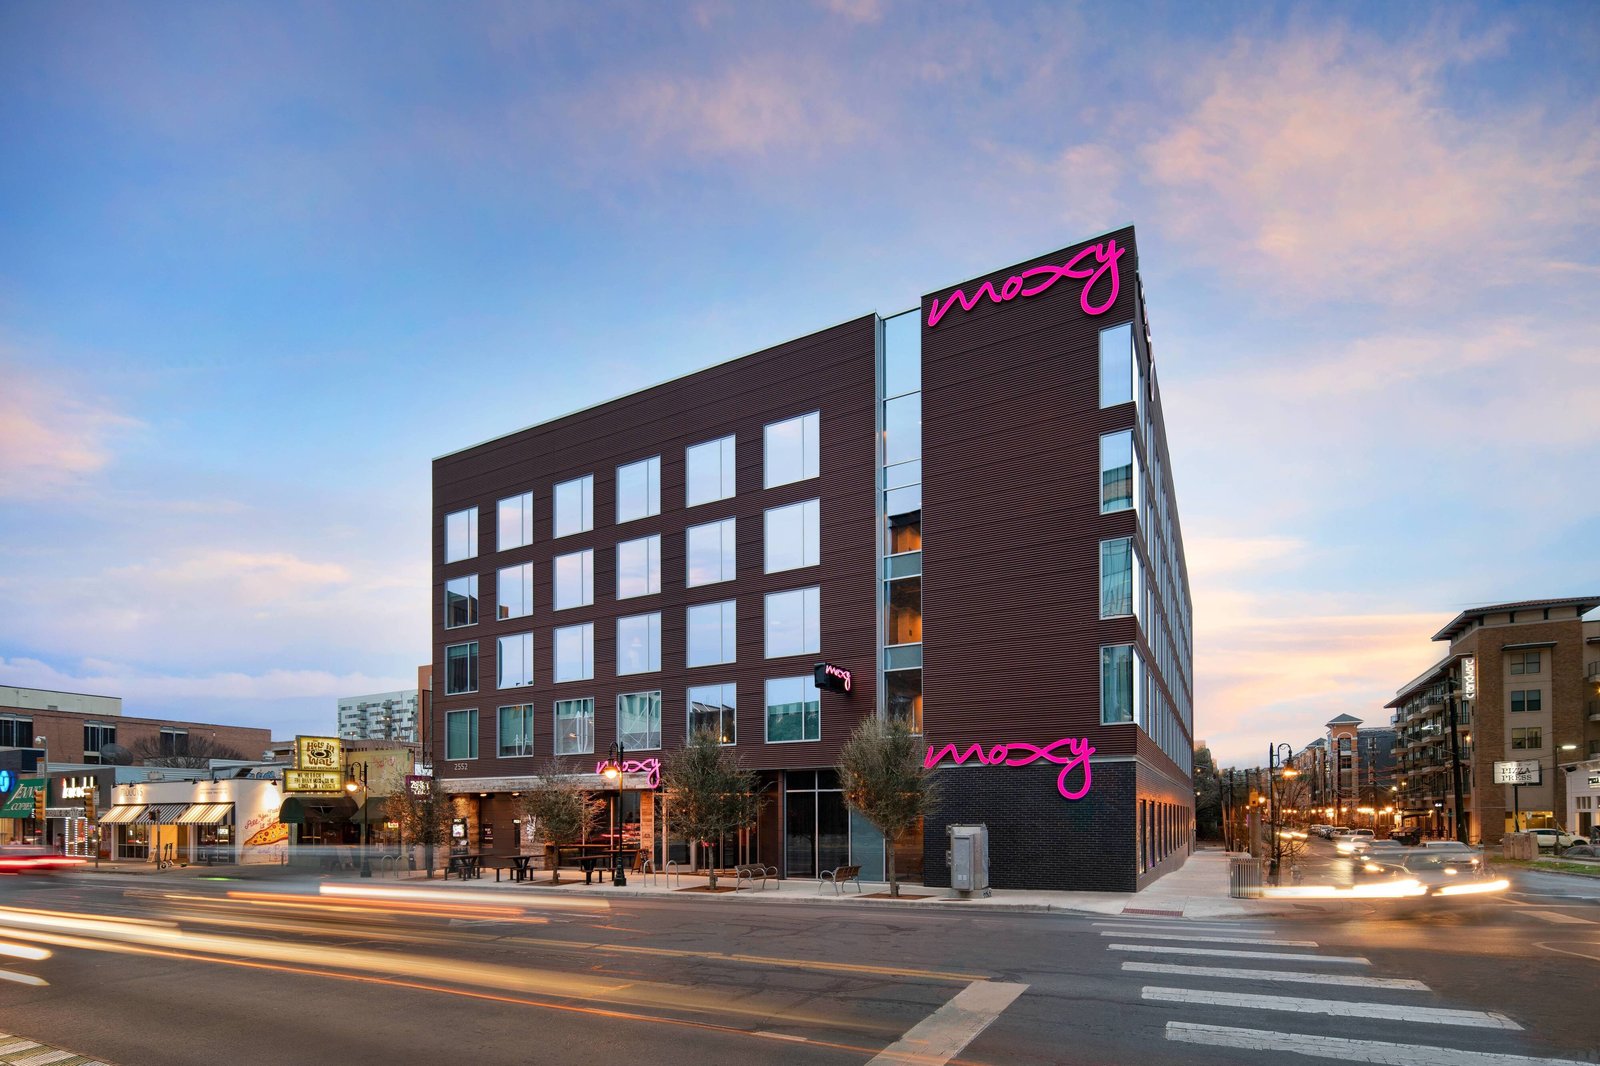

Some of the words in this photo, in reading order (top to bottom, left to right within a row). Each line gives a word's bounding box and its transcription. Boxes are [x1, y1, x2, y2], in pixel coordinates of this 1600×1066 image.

[927, 239, 1126, 327] moxy
[923, 737, 1096, 800] moxy
[1502, 767, 1531, 775] PIZZA
